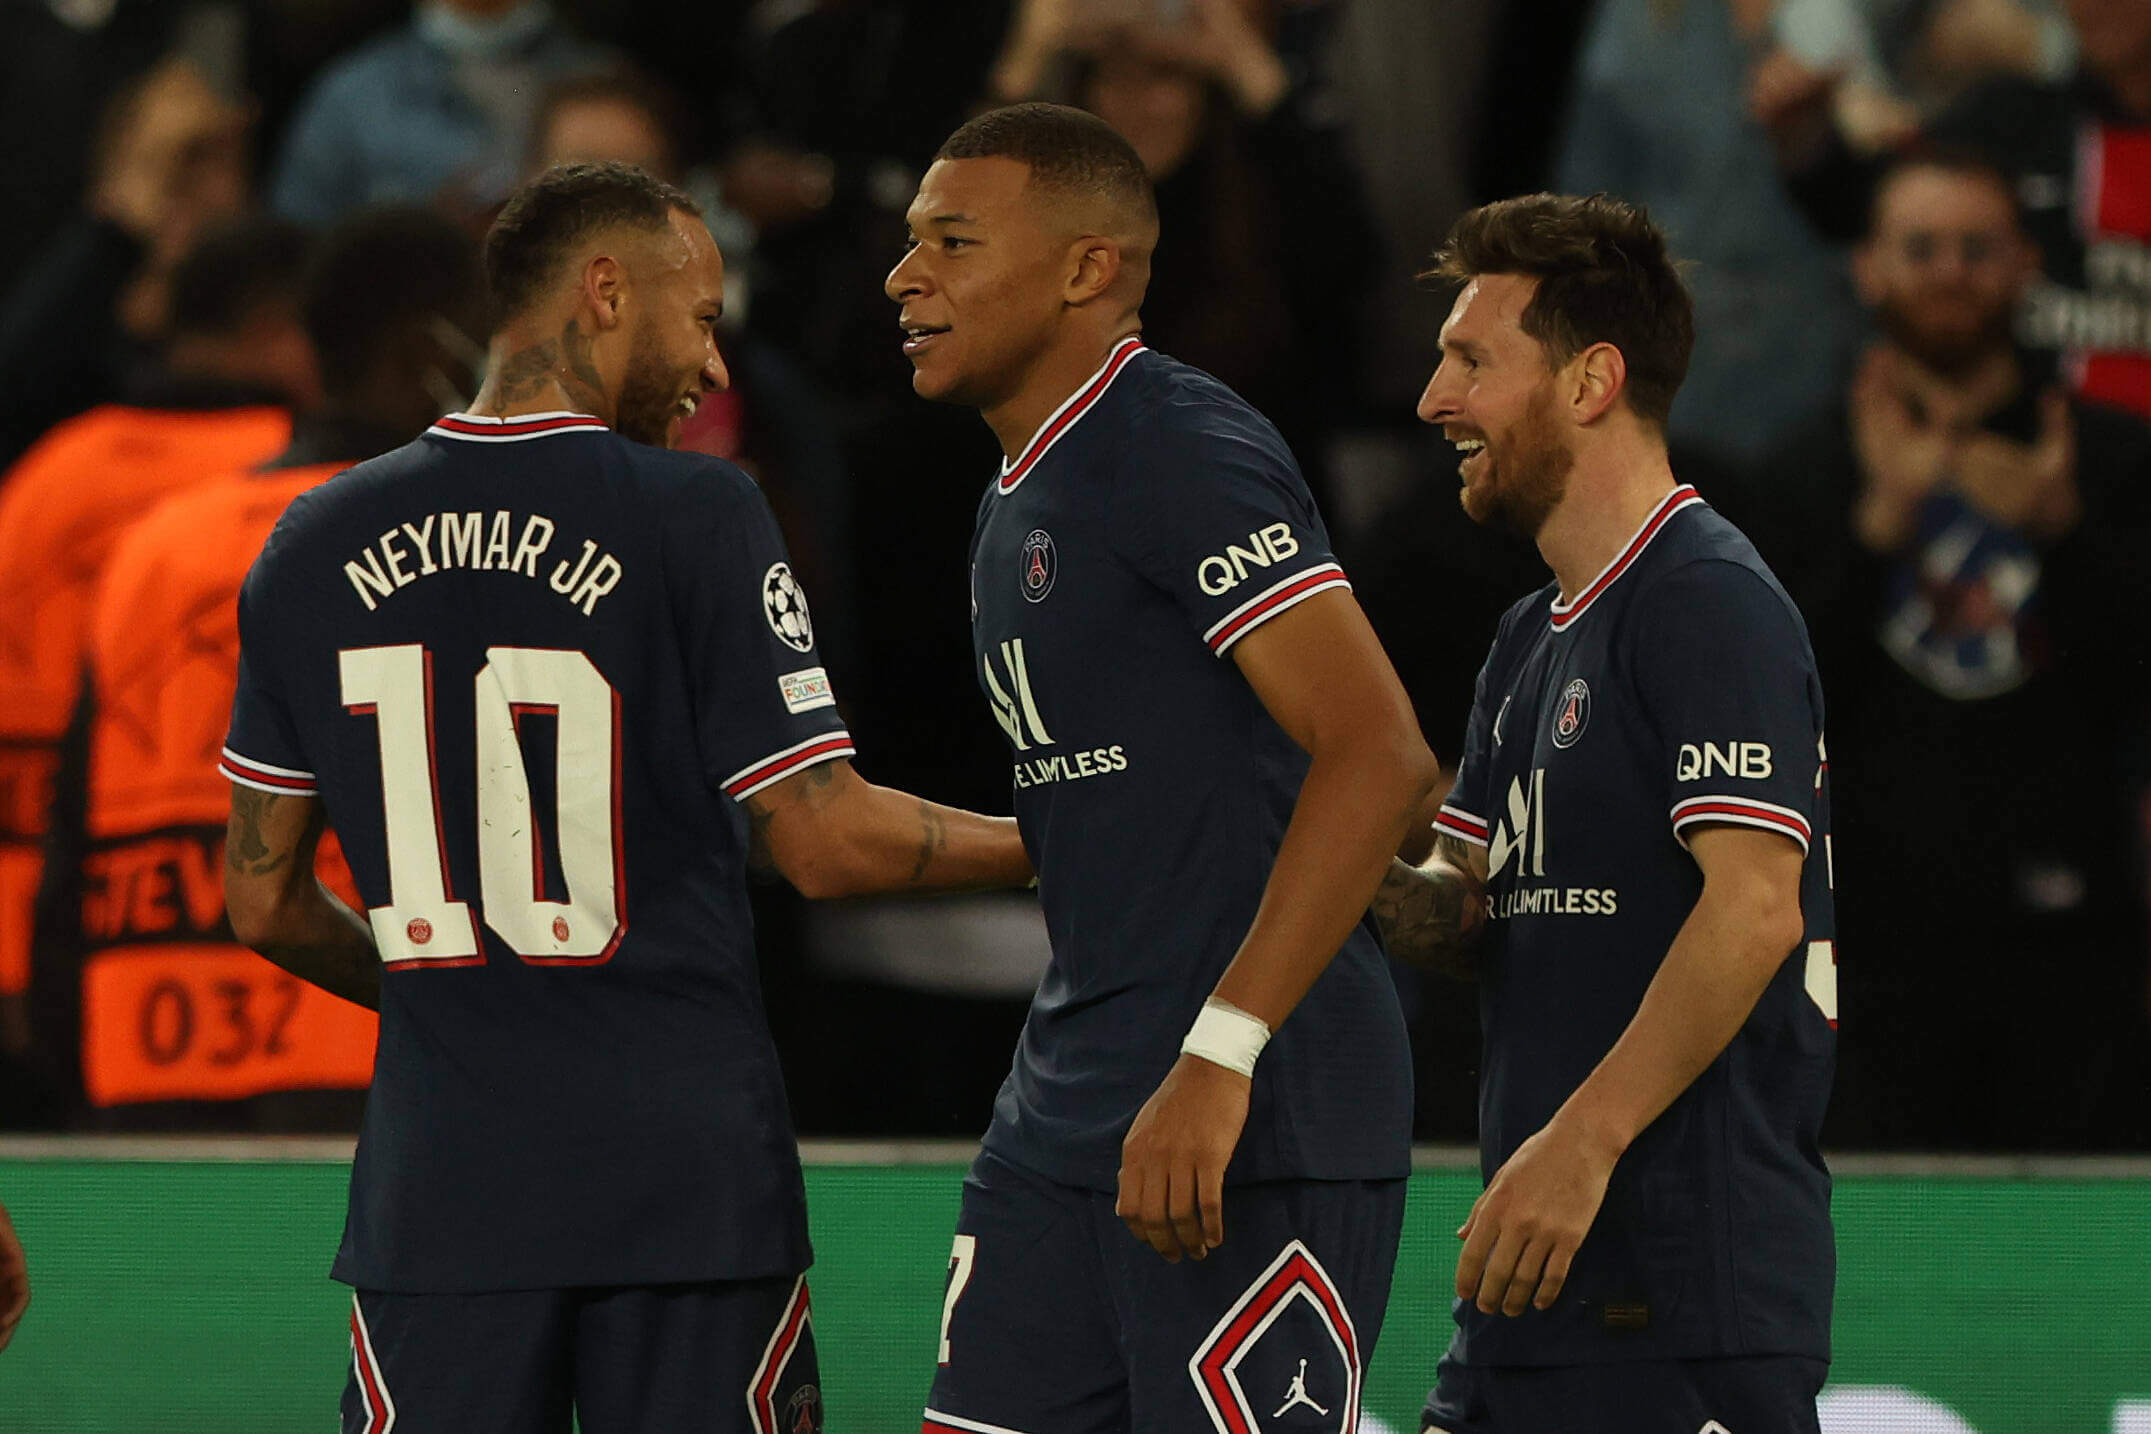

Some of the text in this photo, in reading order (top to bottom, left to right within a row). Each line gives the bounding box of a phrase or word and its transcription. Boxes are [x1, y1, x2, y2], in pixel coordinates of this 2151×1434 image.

[342, 509, 623, 617] NEYMAR JR
[1197, 521, 1300, 597] QNB
[1676, 740, 1774, 782] QNB
[338, 641, 629, 969] 10
[1512, 887, 1618, 916] LIMITLESS
